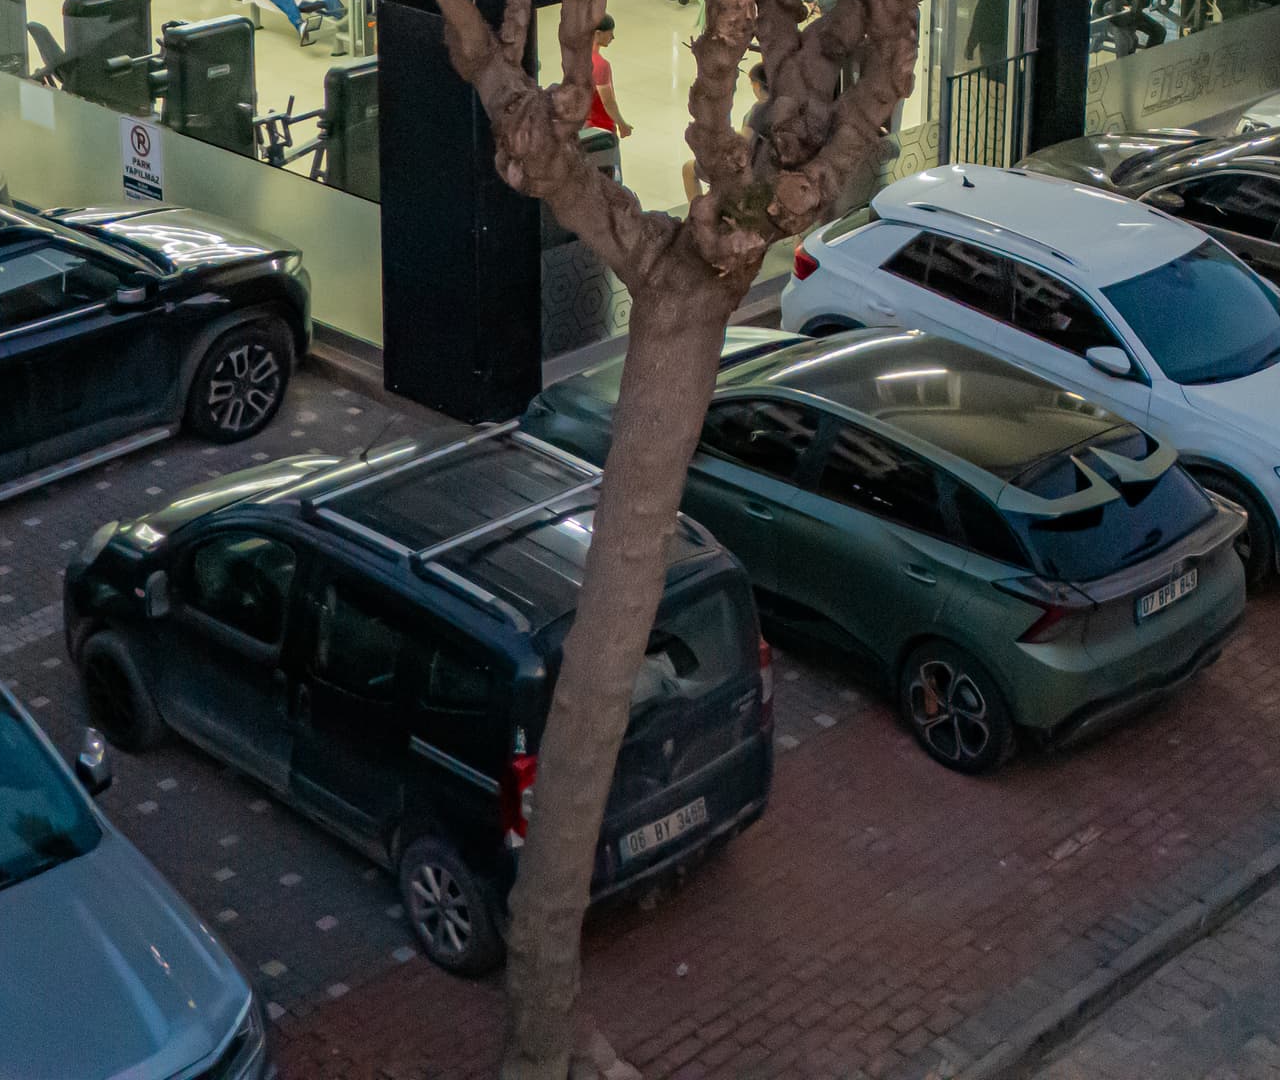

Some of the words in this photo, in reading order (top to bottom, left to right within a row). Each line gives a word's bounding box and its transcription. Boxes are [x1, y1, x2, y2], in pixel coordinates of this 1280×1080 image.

[132, 156, 152, 172] PARK
[124, 164, 160, 186] YAPILMAZ
[1143, 593, 1156, 614] 07
[629, 829, 647, 853] 06
[654, 820, 671, 842] BY
